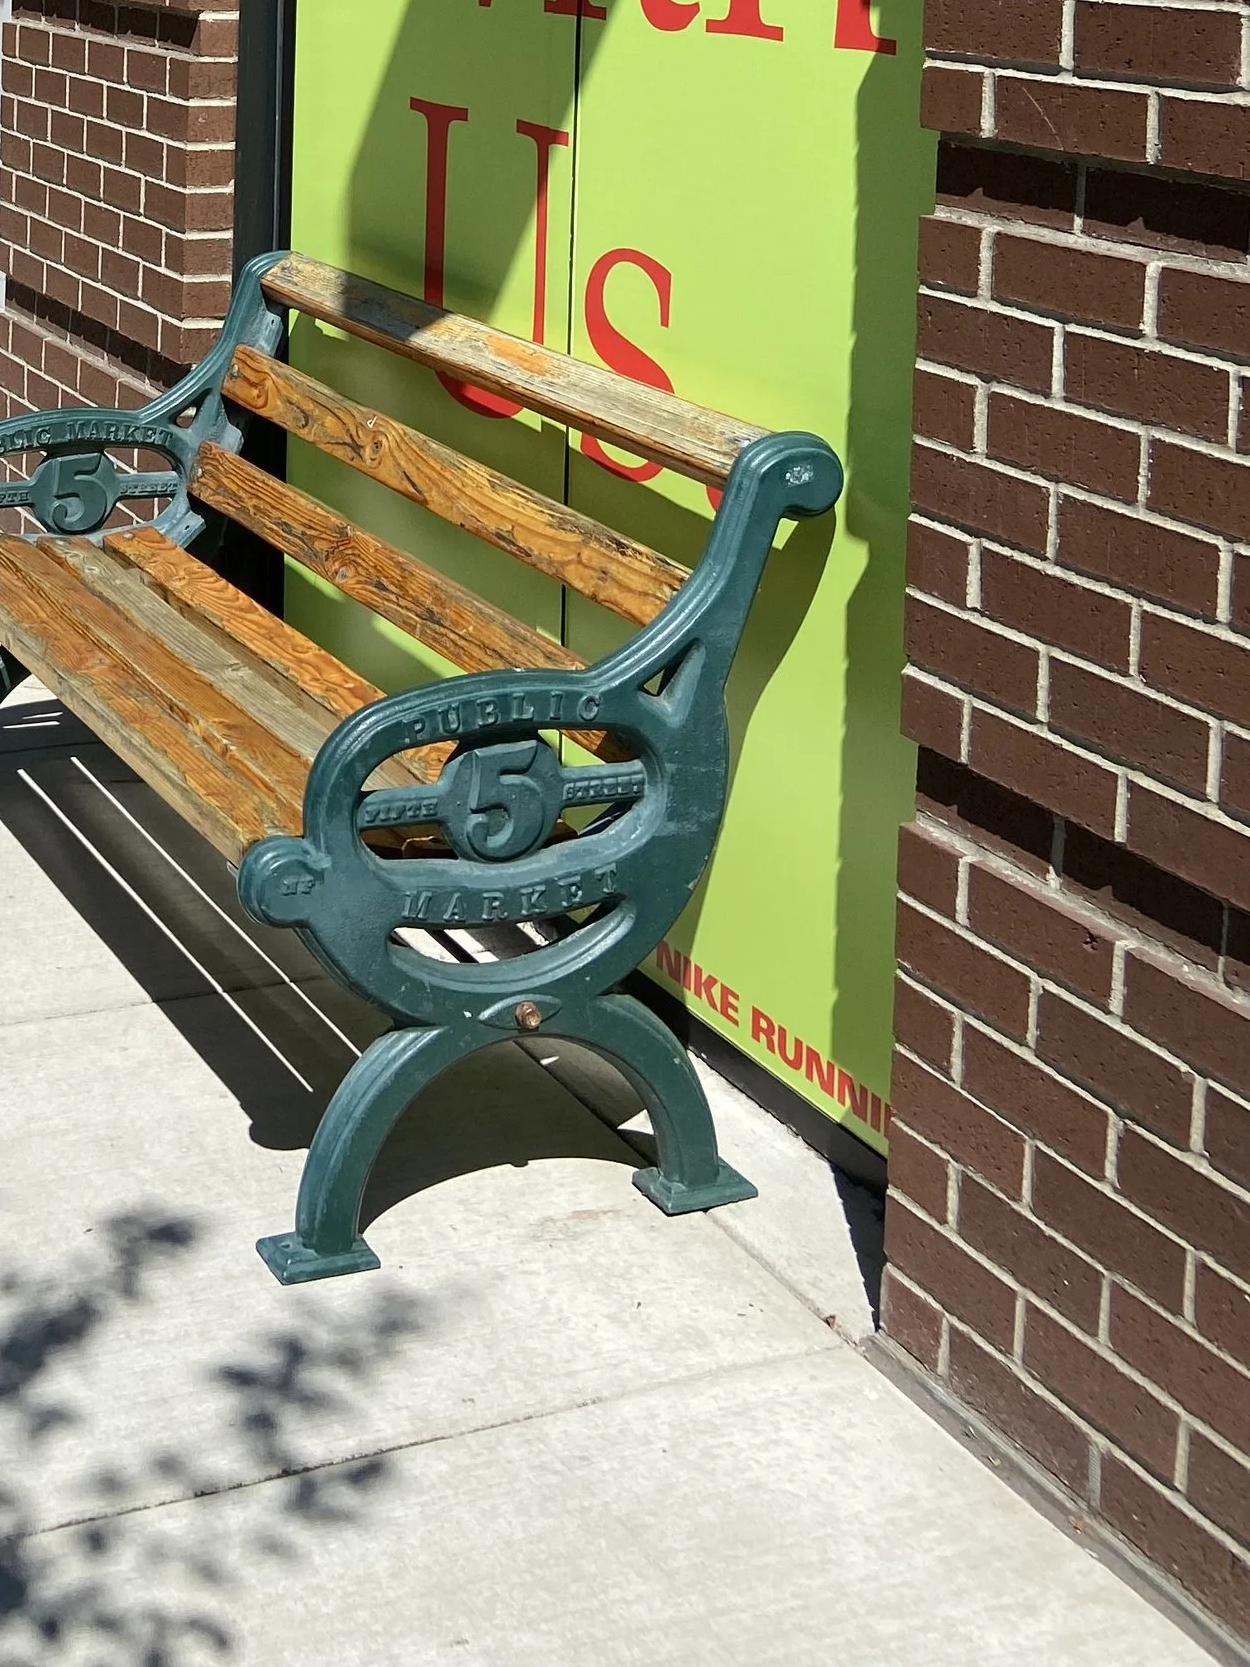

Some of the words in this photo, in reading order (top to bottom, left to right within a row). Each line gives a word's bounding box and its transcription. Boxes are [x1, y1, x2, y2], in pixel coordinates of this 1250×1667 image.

[66, 420, 174, 447] MARKET
[51, 452, 108, 533] 5
[402, 690, 603, 744] PUBLIC
[465, 738, 546, 862] 5
[400, 865, 621, 924] MARKET
[656, 939, 740, 1028] NIKE
[751, 1005, 892, 1134] RUNNI
